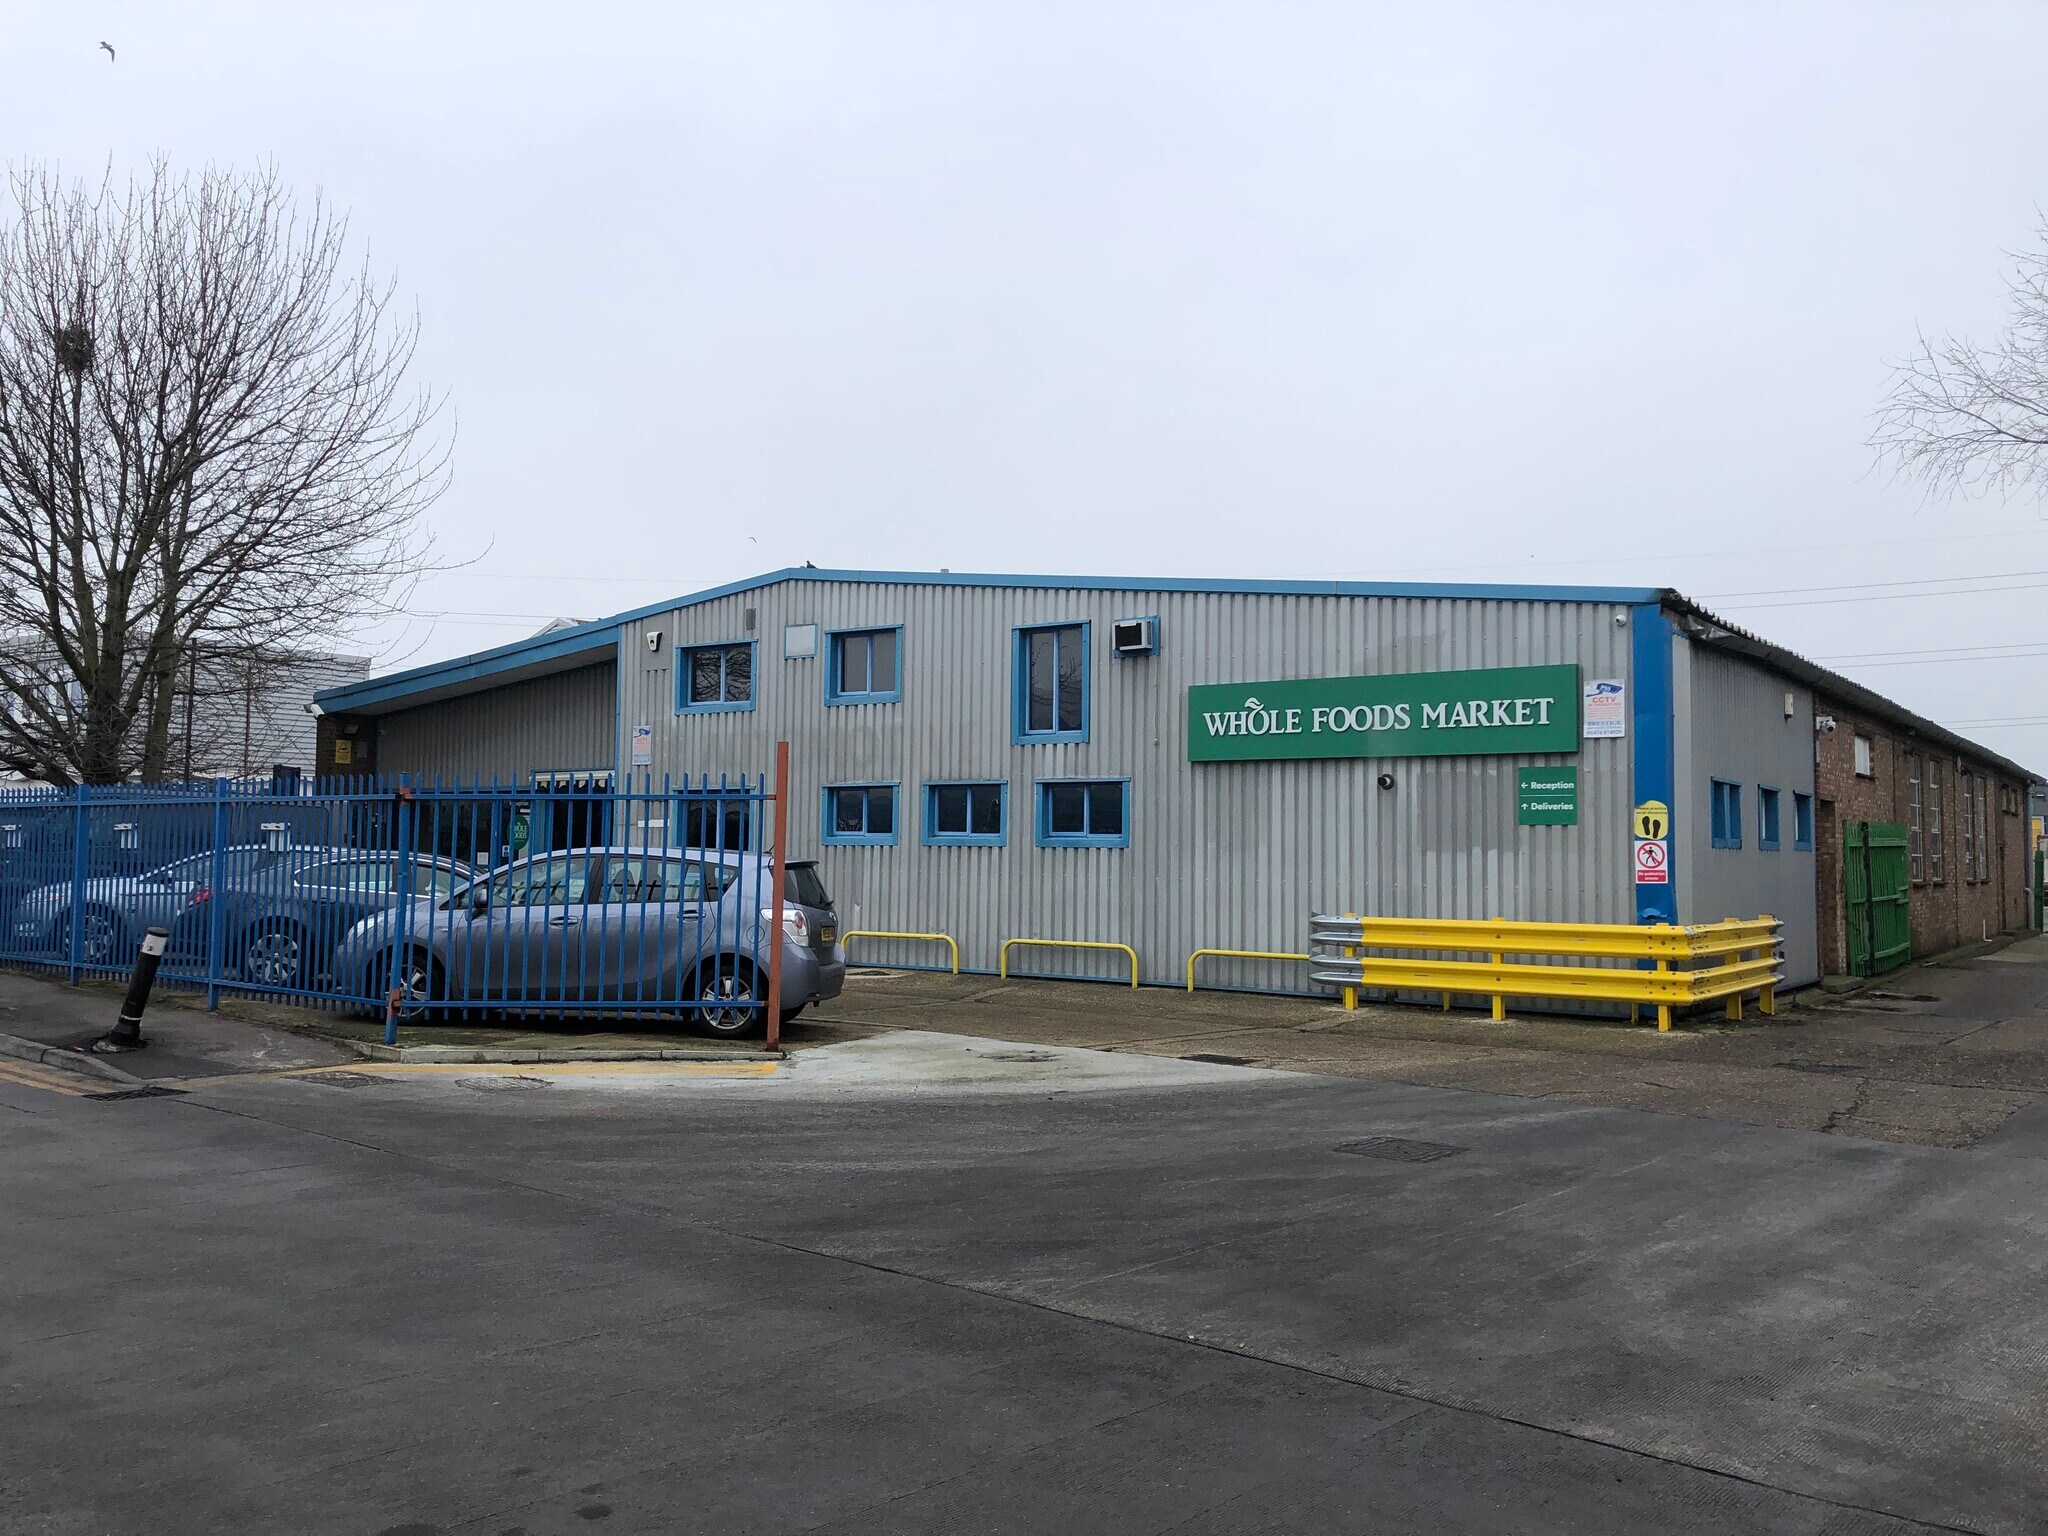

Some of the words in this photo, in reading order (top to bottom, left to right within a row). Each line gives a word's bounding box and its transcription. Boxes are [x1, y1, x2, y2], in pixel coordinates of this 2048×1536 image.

[1202, 697, 1302, 736] WHOLE
[1311, 703, 1411, 733] FOODS
[1420, 697, 1554, 729] MARKET
[1530, 781, 1575, 791] Reception
[1530, 802, 1574, 811] Deliveries
